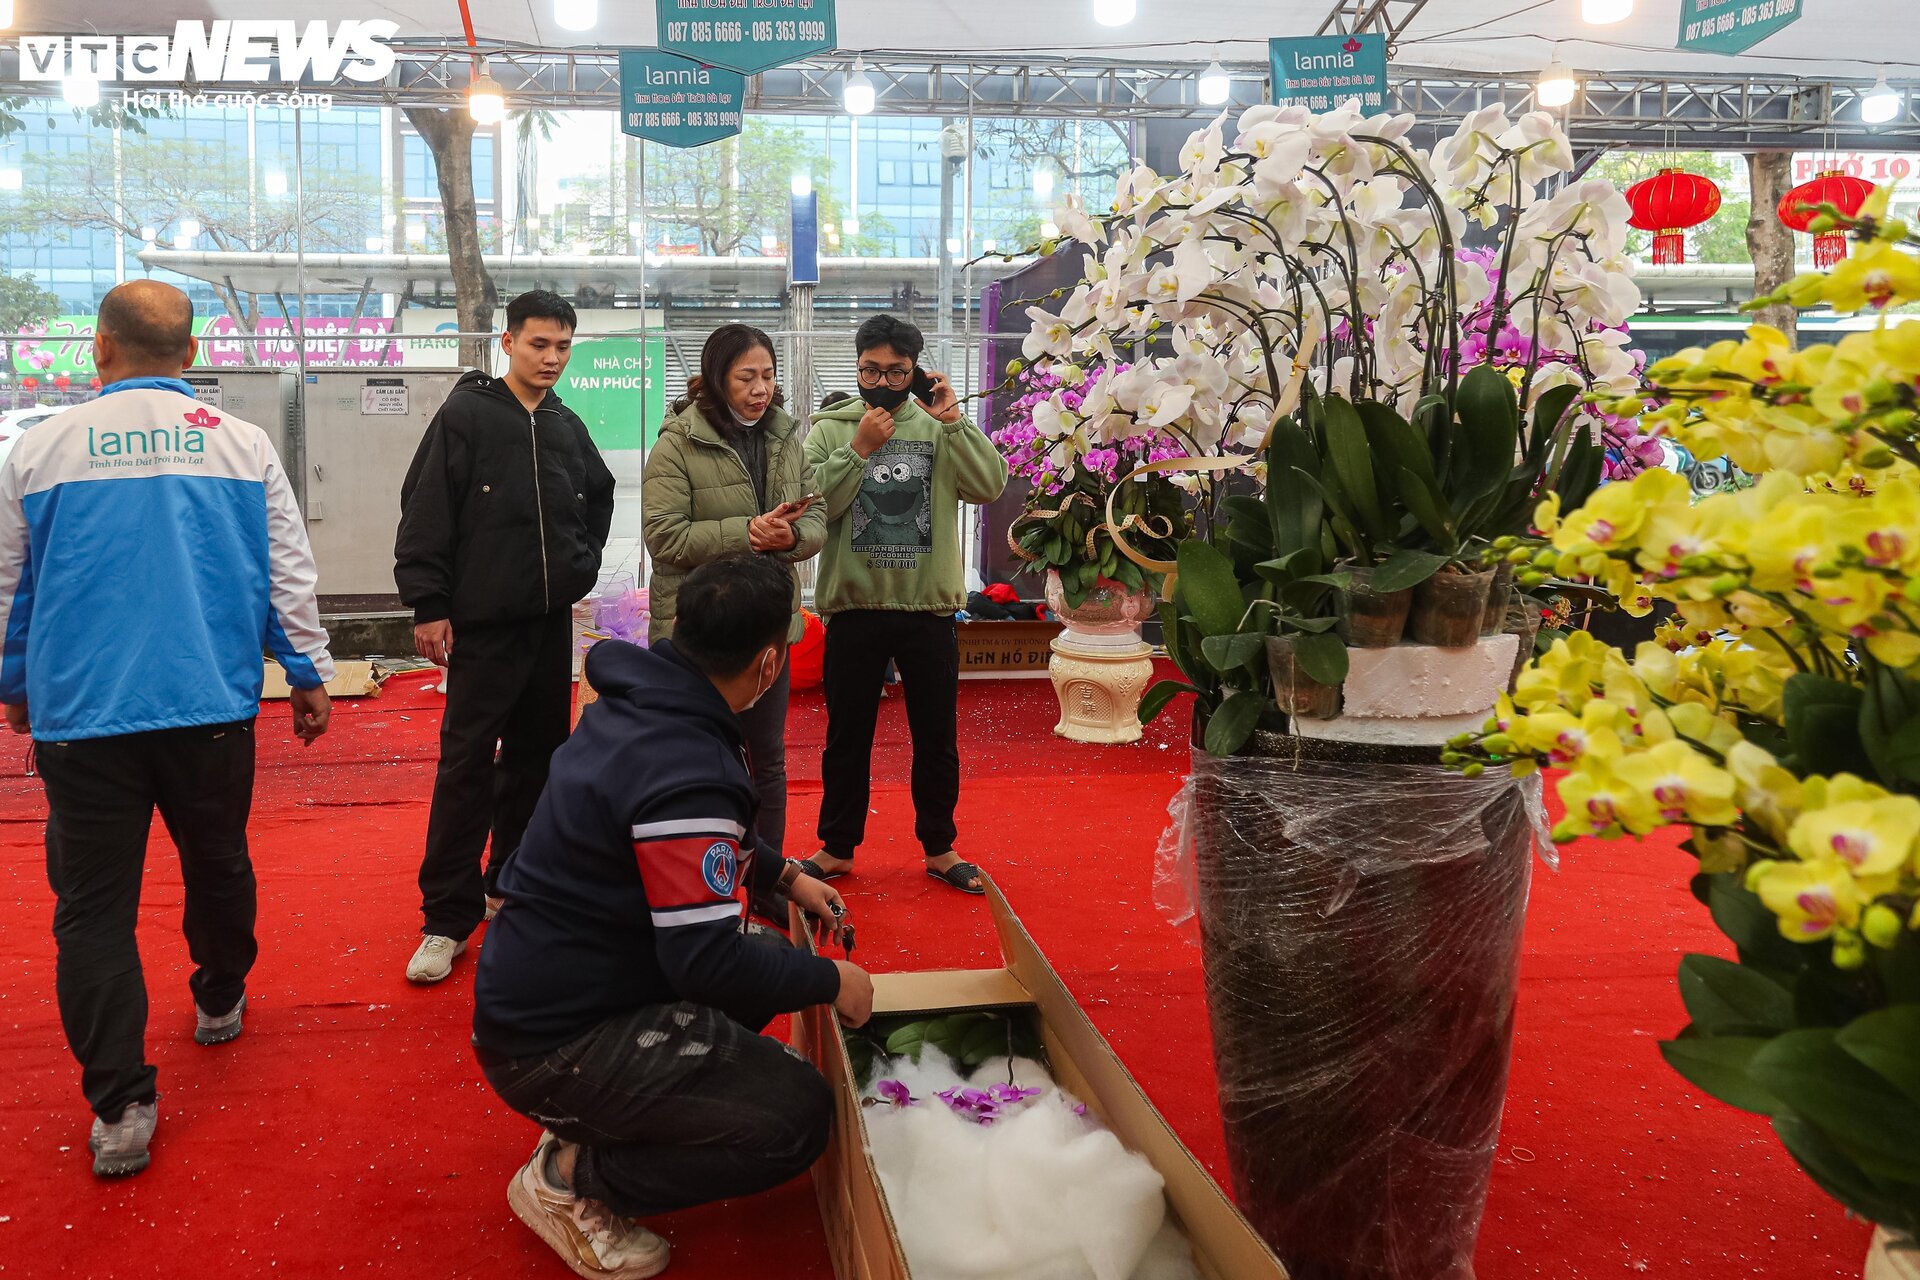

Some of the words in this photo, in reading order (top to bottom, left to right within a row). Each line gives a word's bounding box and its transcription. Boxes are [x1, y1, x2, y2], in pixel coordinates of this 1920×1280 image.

[1685, 22, 1701, 41] 087
[1701, 18, 1715, 37] 885
[1716, 11, 1735, 33] 6666
[1741, 7, 1757, 26] 085
[1758, 3, 1774, 21] 363
[1775, 0, 1796, 17] 9999
[667, 21, 688, 42] 087
[691, 21, 712, 42] 885
[714, 21, 742, 42] 6666
[752, 21, 773, 42] 085
[775, 21, 796, 42] 363
[798, 21, 825, 42] 9999
[1294, 51, 1354, 70] lannia
[645, 65, 710, 85] lannia
[1310, 95, 1327, 109] 6666
[1365, 92, 1381, 106] 9999
[628, 112, 642, 127] 087
[645, 112, 659, 127] 885
[661, 112, 680, 127] 6666
[687, 112, 701, 126] 085
[704, 112, 718, 126] 363
[720, 112, 739, 126] 9999
[1795, 151, 1864, 180] PHỞ
[1870, 159, 1910, 179] 10
[410, 337, 459, 349] HANO
[593, 355, 620, 369] NHÀ
[569, 376, 600, 391] VẠN
[603, 374, 642, 389] PHÚC
[644, 377, 652, 389] 2
[88, 425, 205, 457] lannia
[88, 459, 111, 469] Tinh
[113, 458, 133, 467] Hoa
[135, 456, 152, 466] Đất
[173, 455, 185, 463] Đà
[188, 456, 204, 465] Lạt
[710, 845, 732, 859] PARIS
